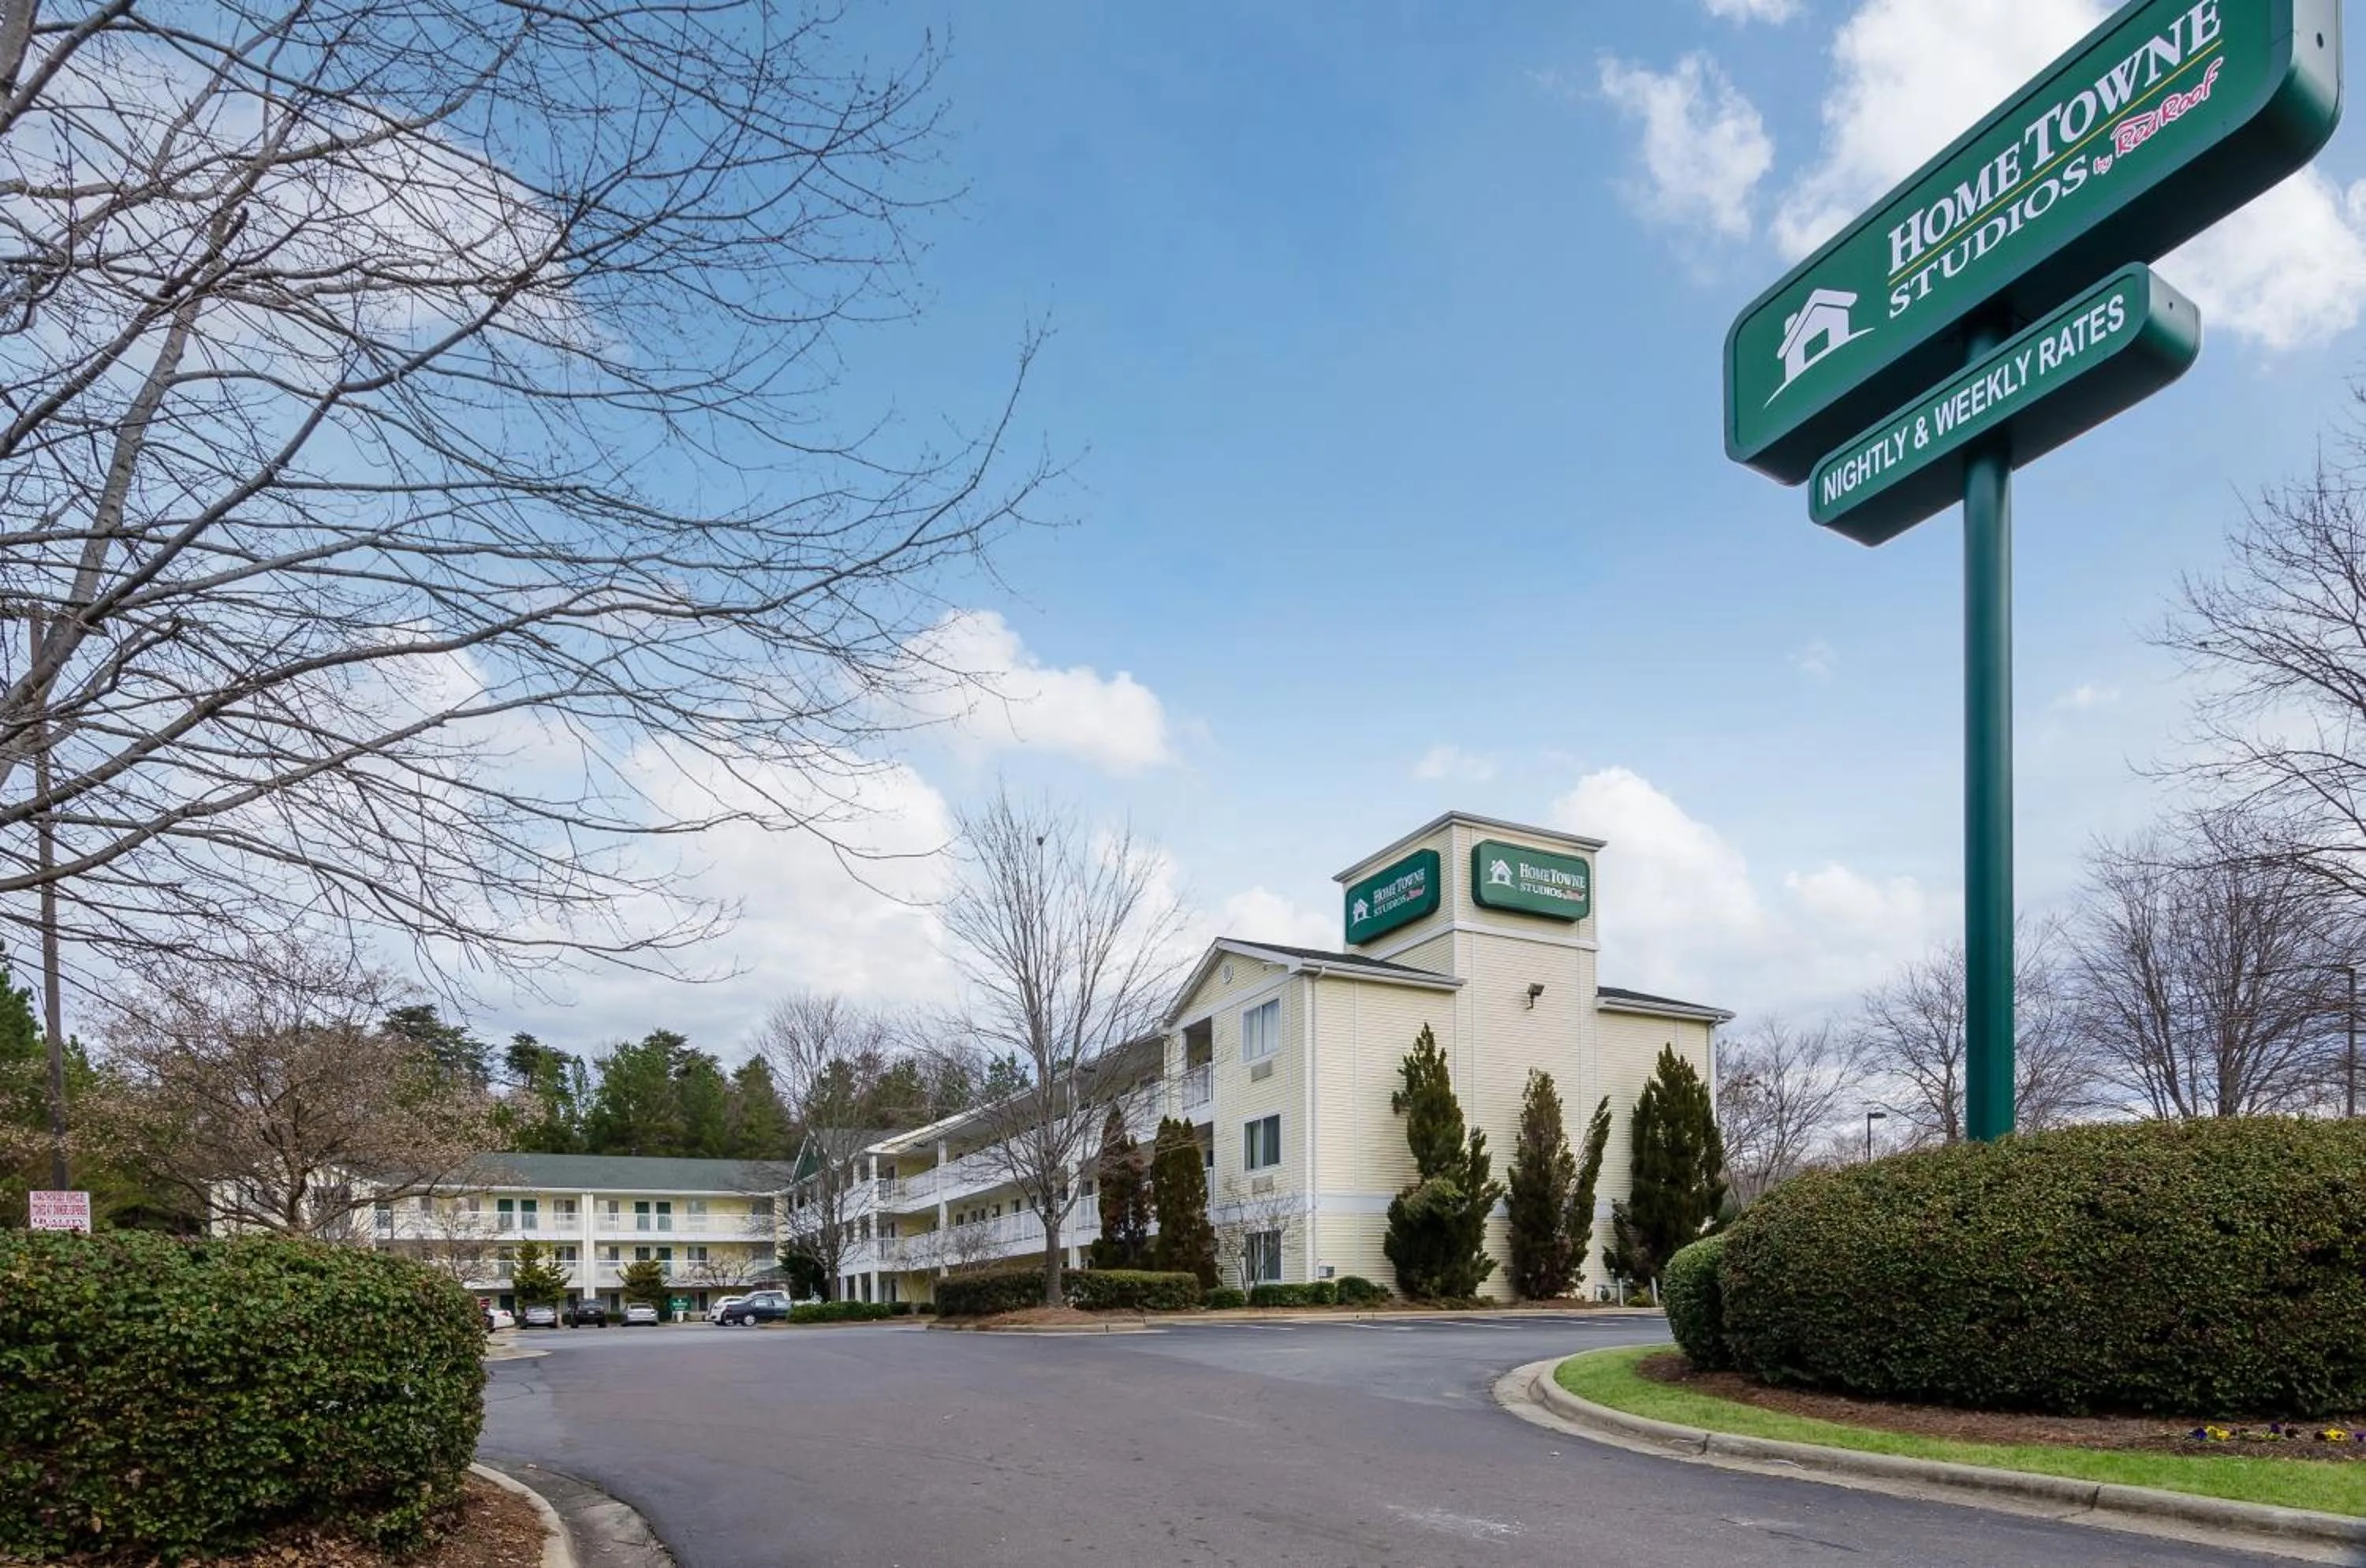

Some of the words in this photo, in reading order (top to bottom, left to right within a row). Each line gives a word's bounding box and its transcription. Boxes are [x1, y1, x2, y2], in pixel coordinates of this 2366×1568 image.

[1890, 155, 2088, 319] STUDIOS
[2093, 155, 2113, 174] by
[1823, 427, 1909, 506] NIGHTLY
[1914, 416, 1929, 450] &
[1935, 350, 2032, 437] WEEKLY
[2039, 293, 2125, 375] RATES
[1374, 894, 1405, 917] STUDIOS
[1521, 883, 1562, 898] STUDIOS
